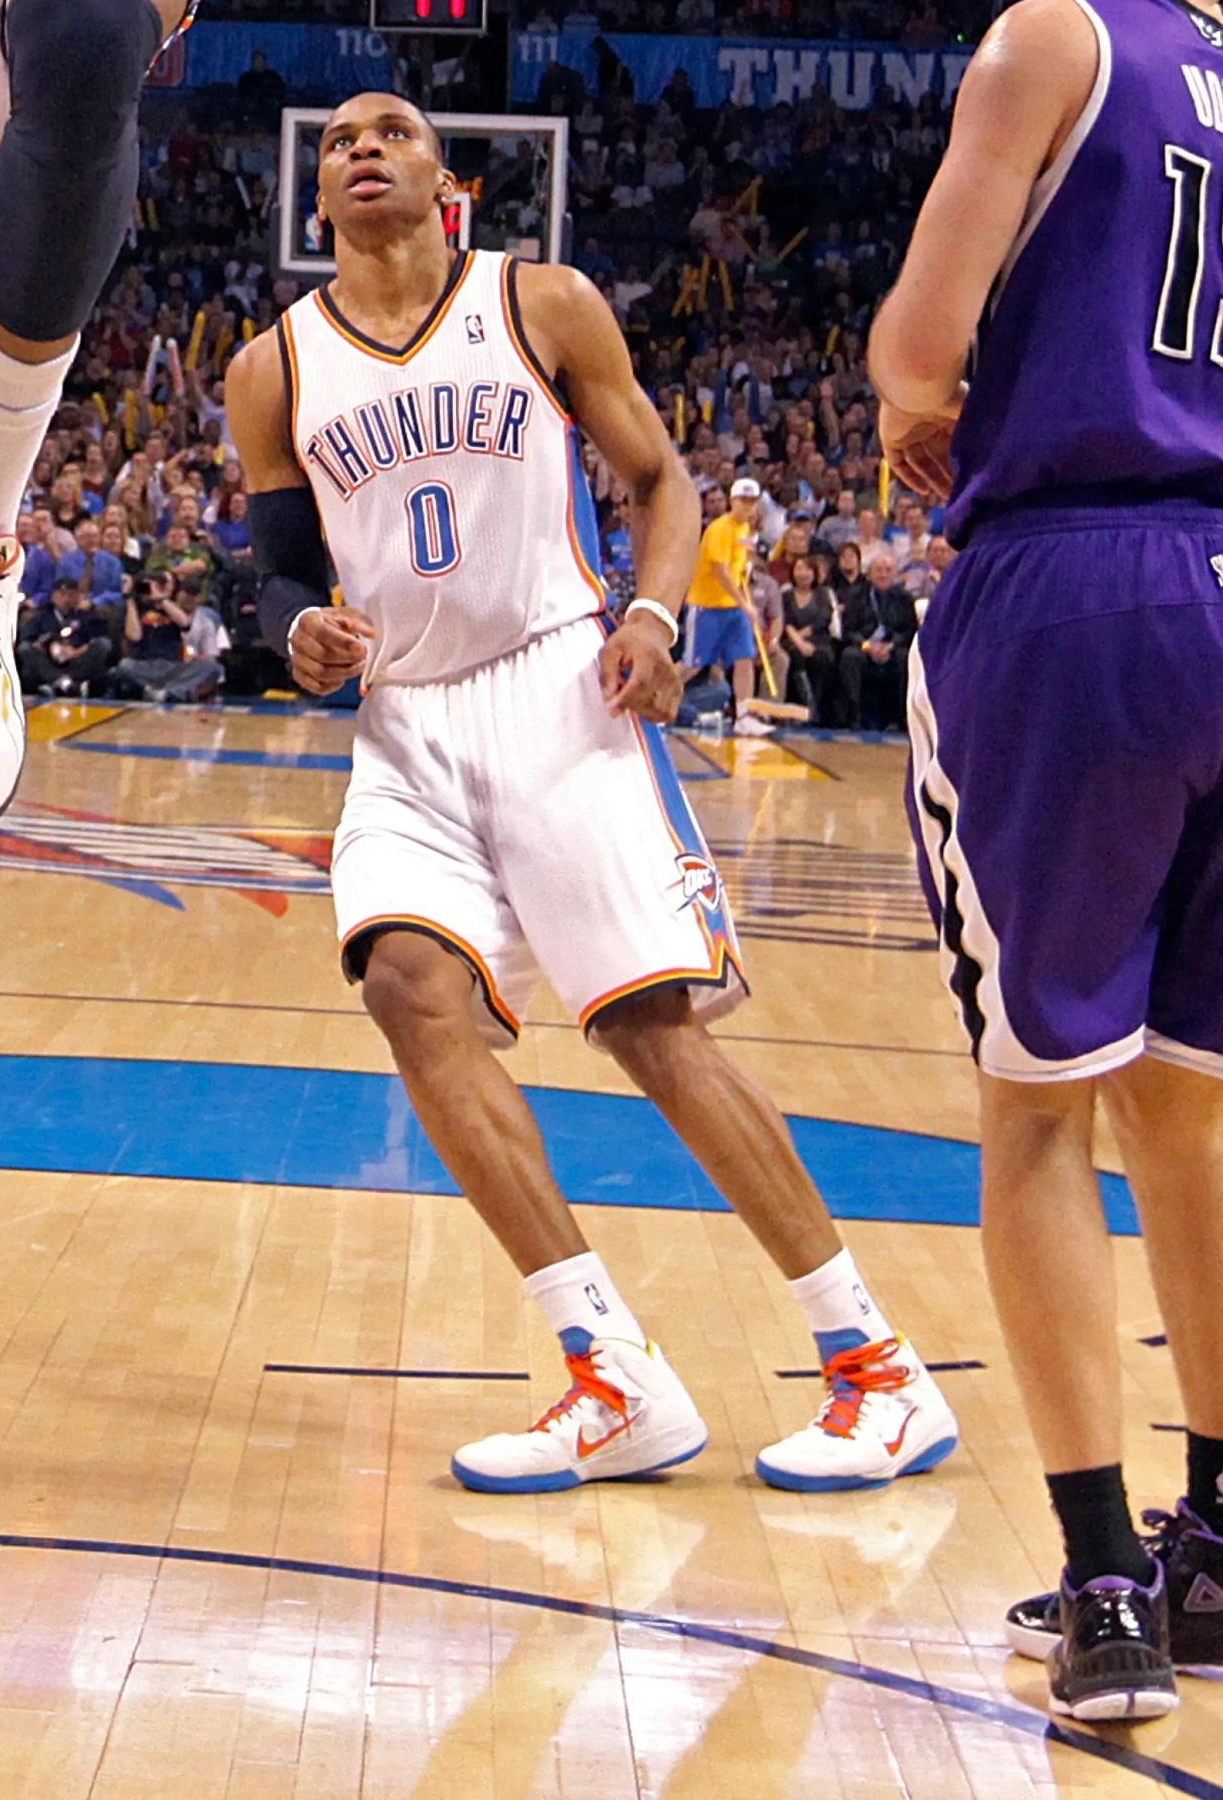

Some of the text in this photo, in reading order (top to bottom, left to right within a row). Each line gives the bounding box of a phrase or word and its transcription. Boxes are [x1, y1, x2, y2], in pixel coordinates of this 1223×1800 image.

[335, 29, 388, 58] 110
[518, 33, 558, 62] 111
[304, 381, 534, 502] THUNDER
[404, 479, 462, 578] 0
